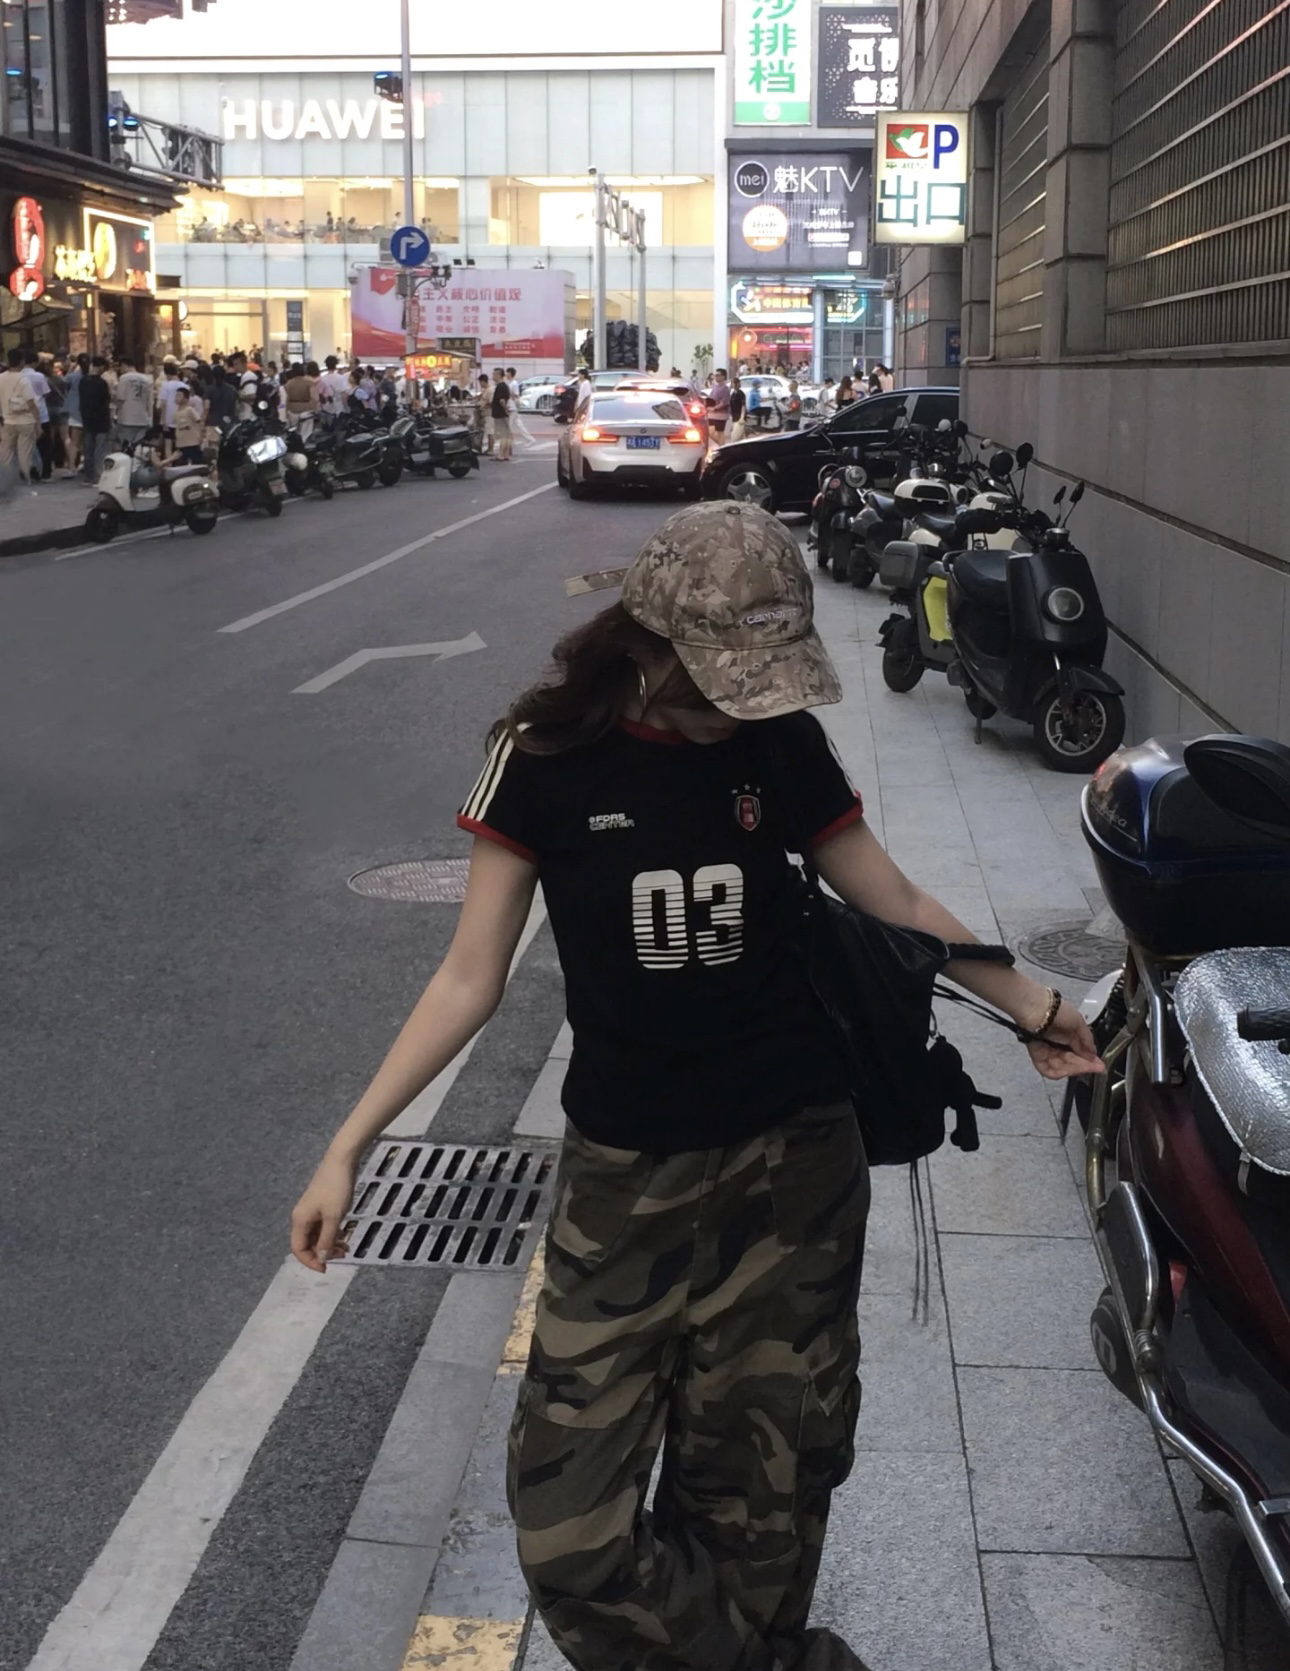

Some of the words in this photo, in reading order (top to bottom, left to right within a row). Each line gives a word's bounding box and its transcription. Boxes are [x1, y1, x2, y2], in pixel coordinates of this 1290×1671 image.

[223, 99, 425, 140] HUAWEI
[933, 124, 959, 169] P
[740, 174, 765, 186] mei
[773, 165, 863, 193] 魅KTV
[877, 175, 966, 227] 出口
[632, 863, 744, 969] 03
